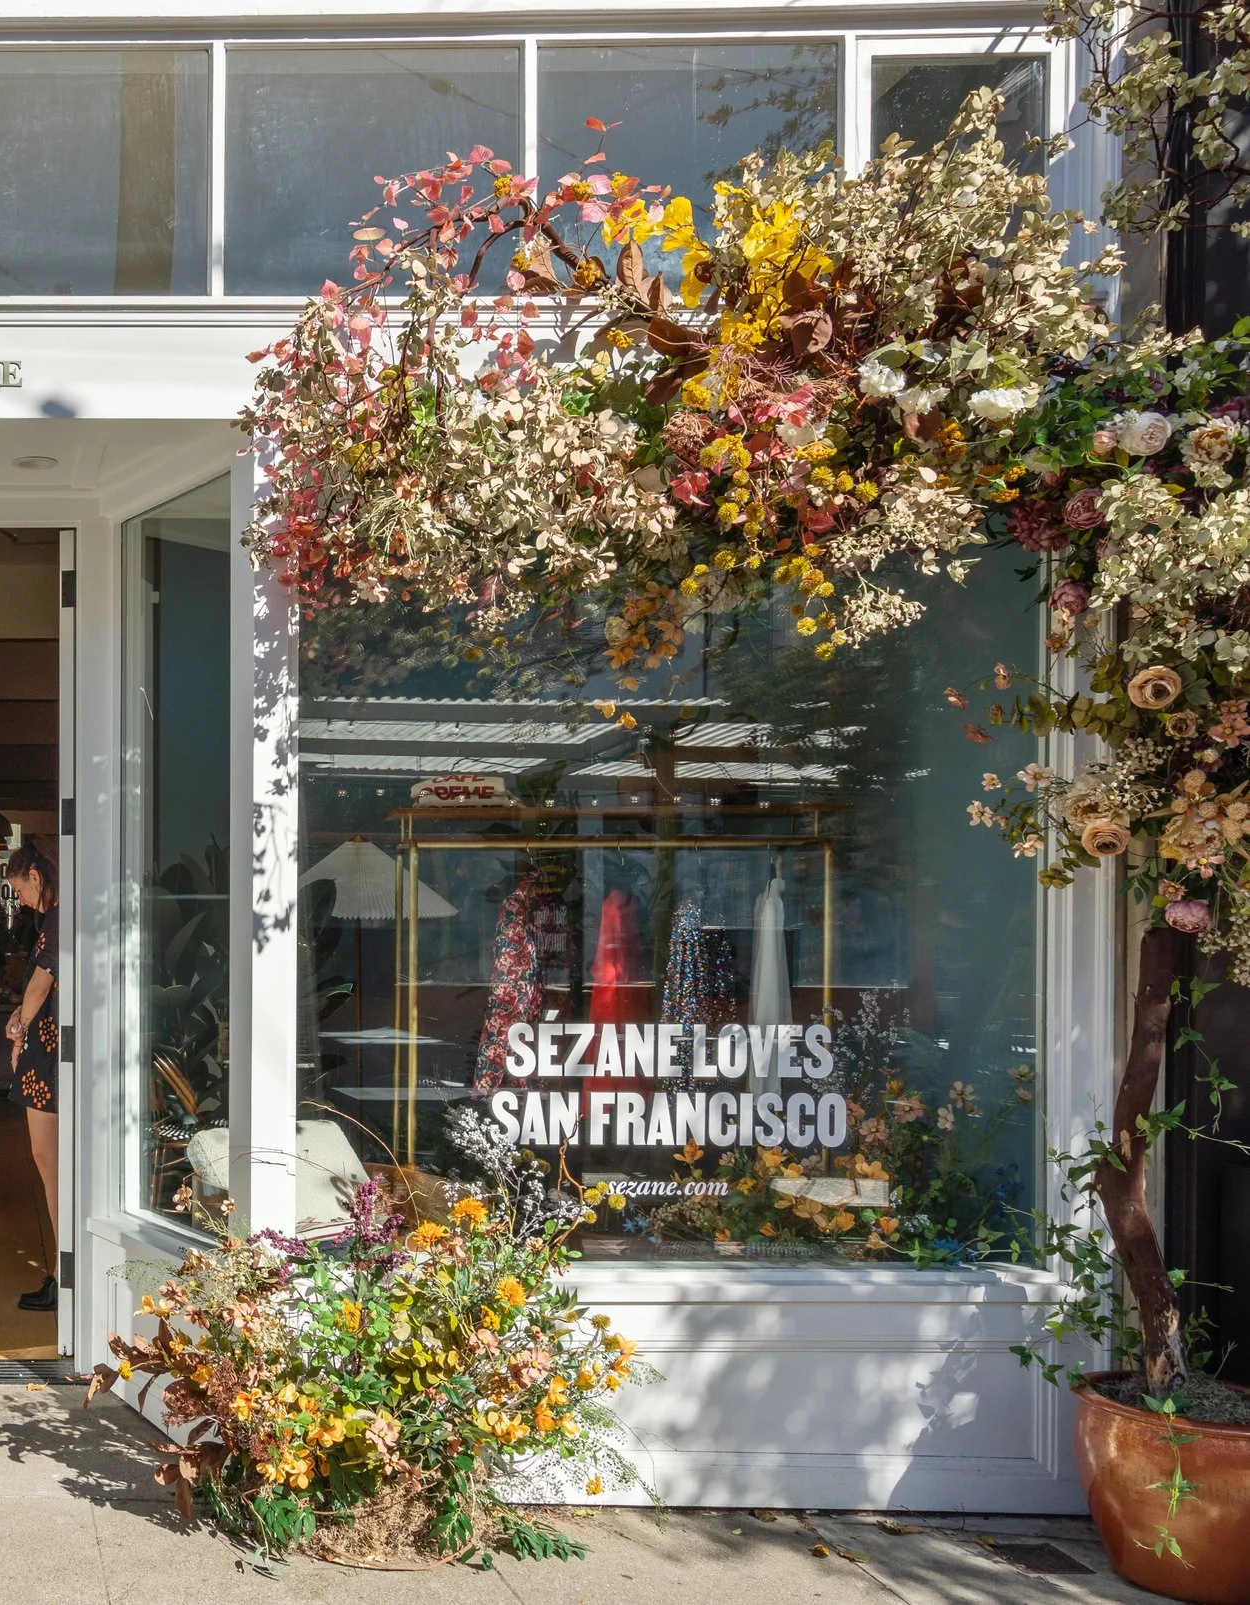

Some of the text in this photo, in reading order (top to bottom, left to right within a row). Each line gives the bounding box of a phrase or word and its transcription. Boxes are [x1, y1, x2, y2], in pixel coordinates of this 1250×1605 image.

[506, 1009, 834, 1079] SÉZANE LOVES
[491, 1090, 847, 1148] SAN FRANCISCO
[607, 1181, 729, 1197] sezane.com
